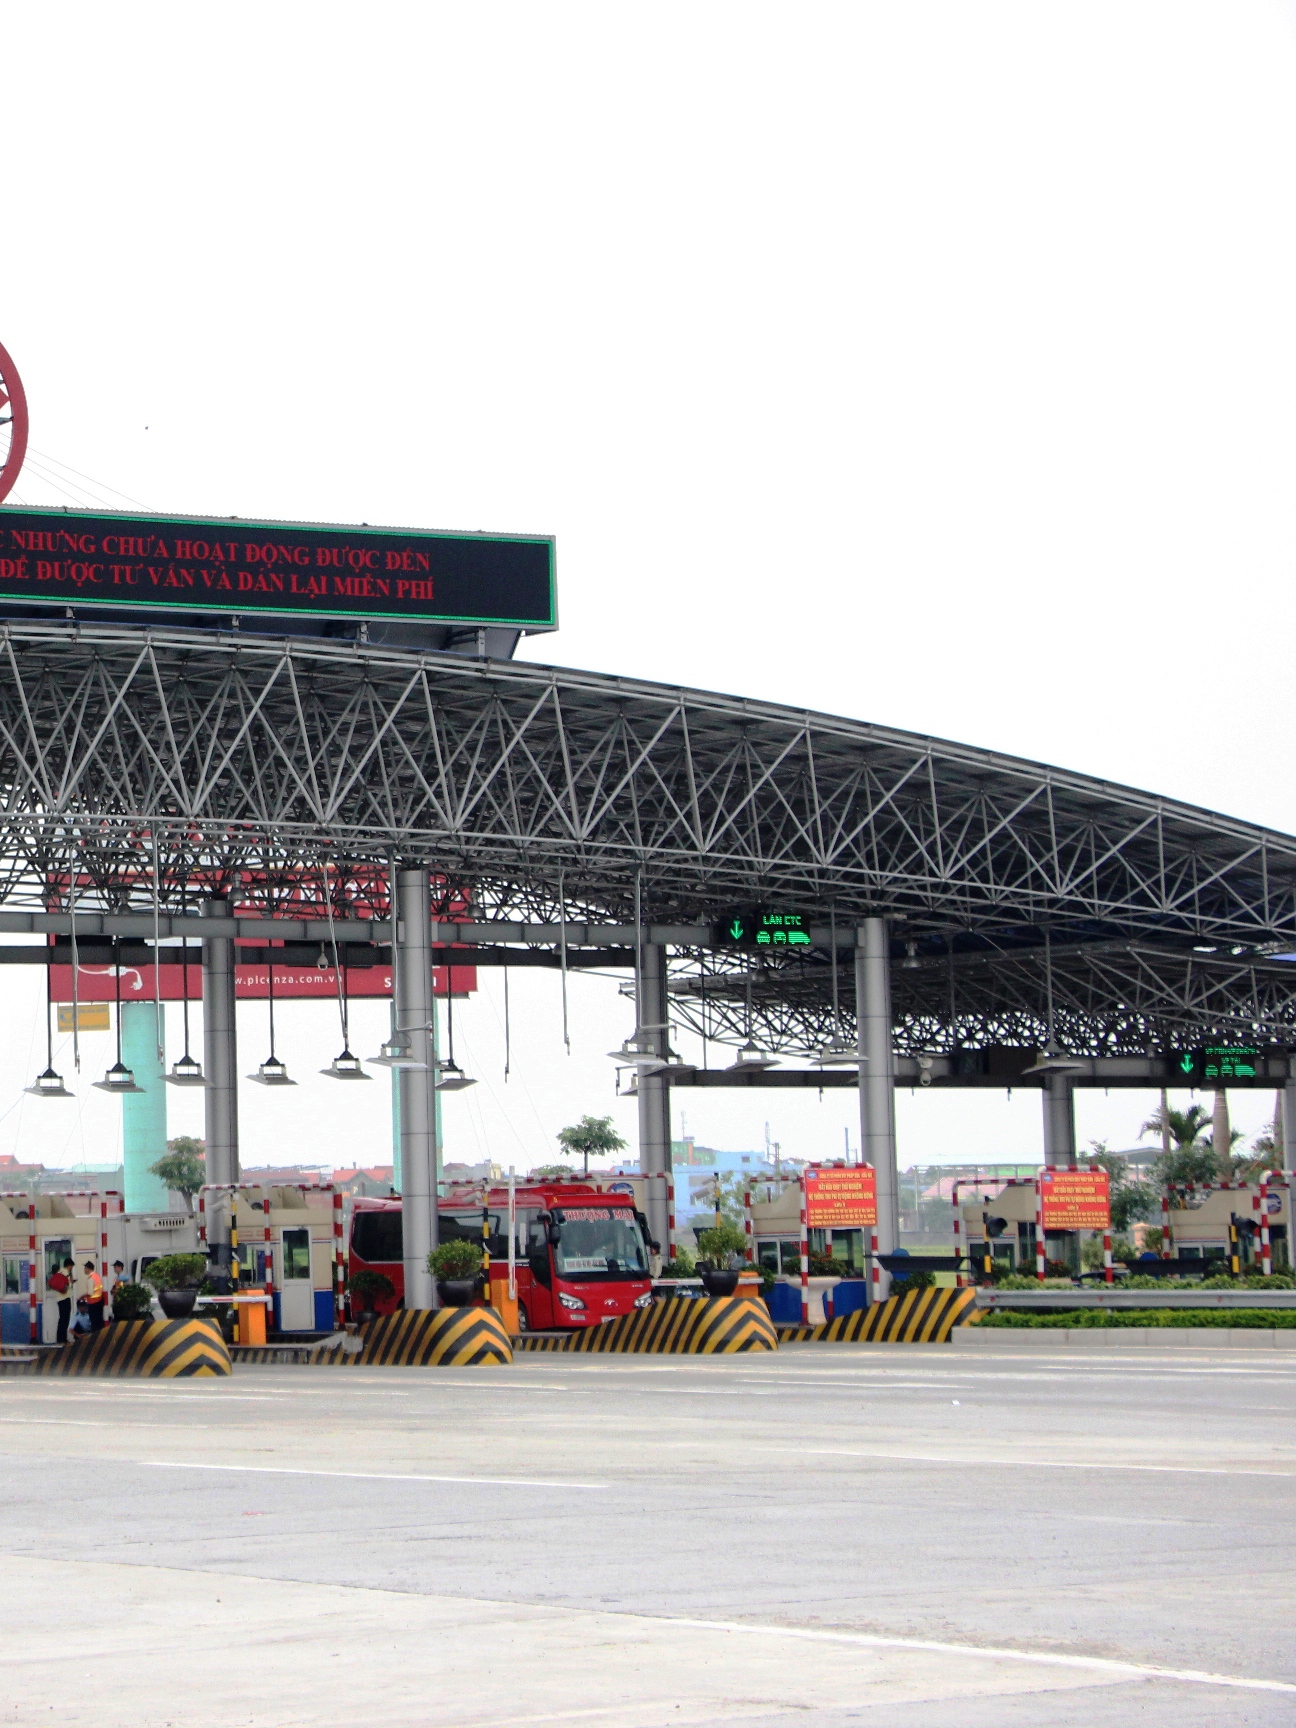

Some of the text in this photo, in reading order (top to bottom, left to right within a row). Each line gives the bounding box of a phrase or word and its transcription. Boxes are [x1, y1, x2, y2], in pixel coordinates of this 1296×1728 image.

[102, 534, 169, 559] CHƯA
[175, 540, 239, 566] HOẠT
[245, 542, 310, 569] ĐỘNG
[316, 546, 380, 573] ĐƯỢC
[36, 558, 104, 587] ĐƯỢC
[109, 563, 145, 585] TƯ
[200, 565, 233, 590] VÀ
[238, 568, 284, 592] DÁN
[289, 574, 328, 599] LẠI
[396, 576, 435, 600] PHÍ
[784, 915, 802, 925] ETC
